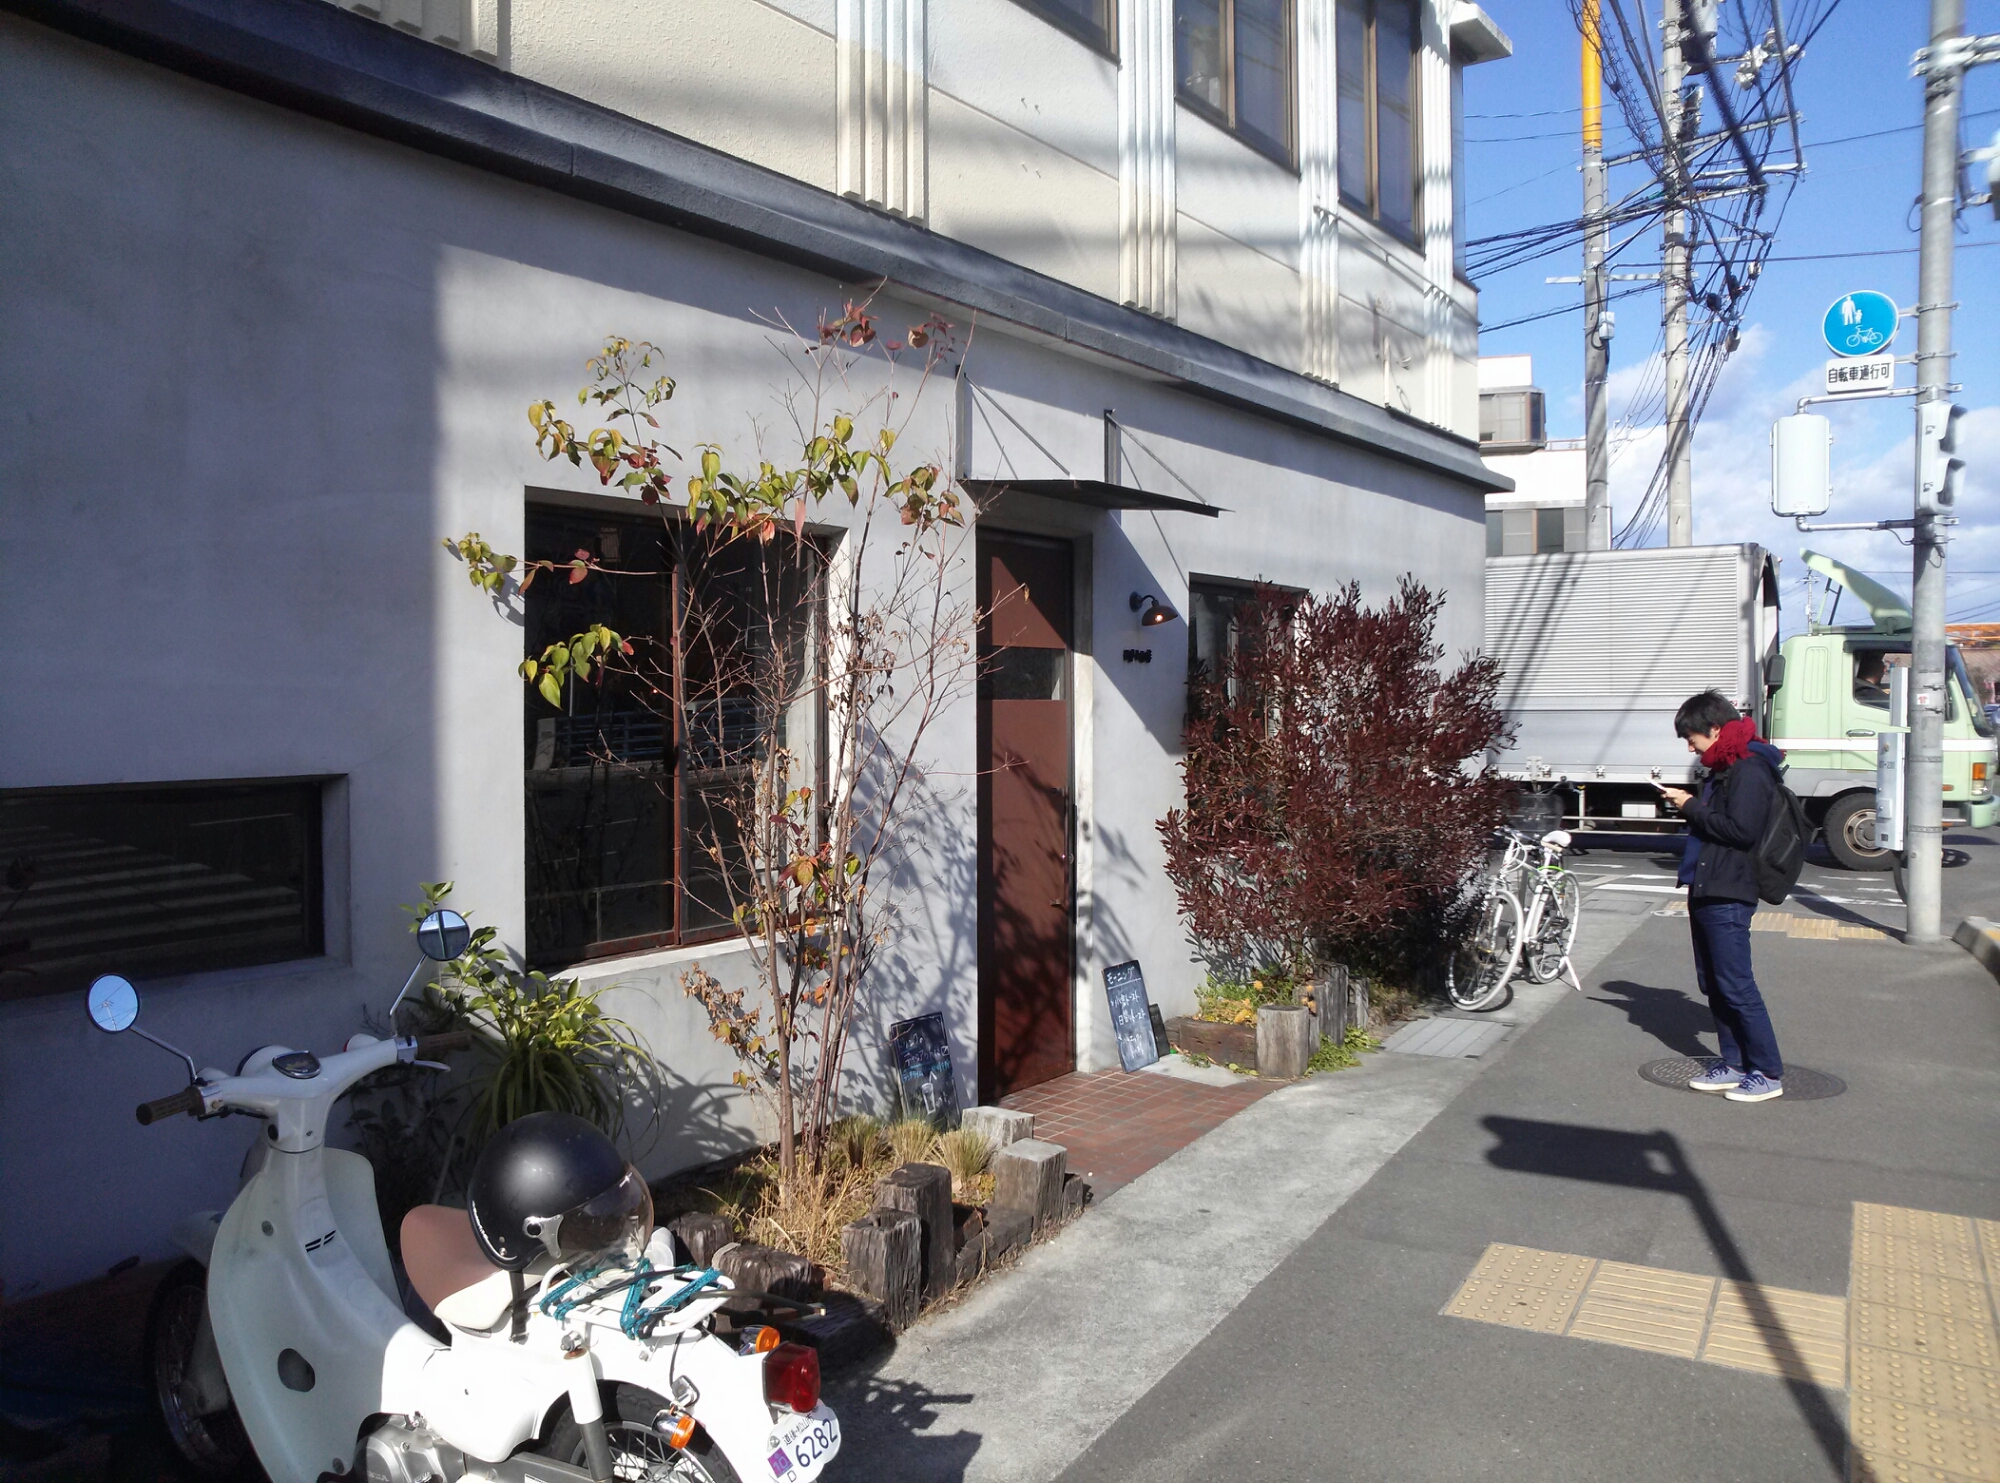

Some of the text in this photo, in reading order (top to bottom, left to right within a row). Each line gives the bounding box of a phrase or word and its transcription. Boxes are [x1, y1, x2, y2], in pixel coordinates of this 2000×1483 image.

[1828, 362, 1891, 383] 自転車通行可
[1107, 966, 1135, 985] モーニング
[796, 1418, 838, 1468] 6282
